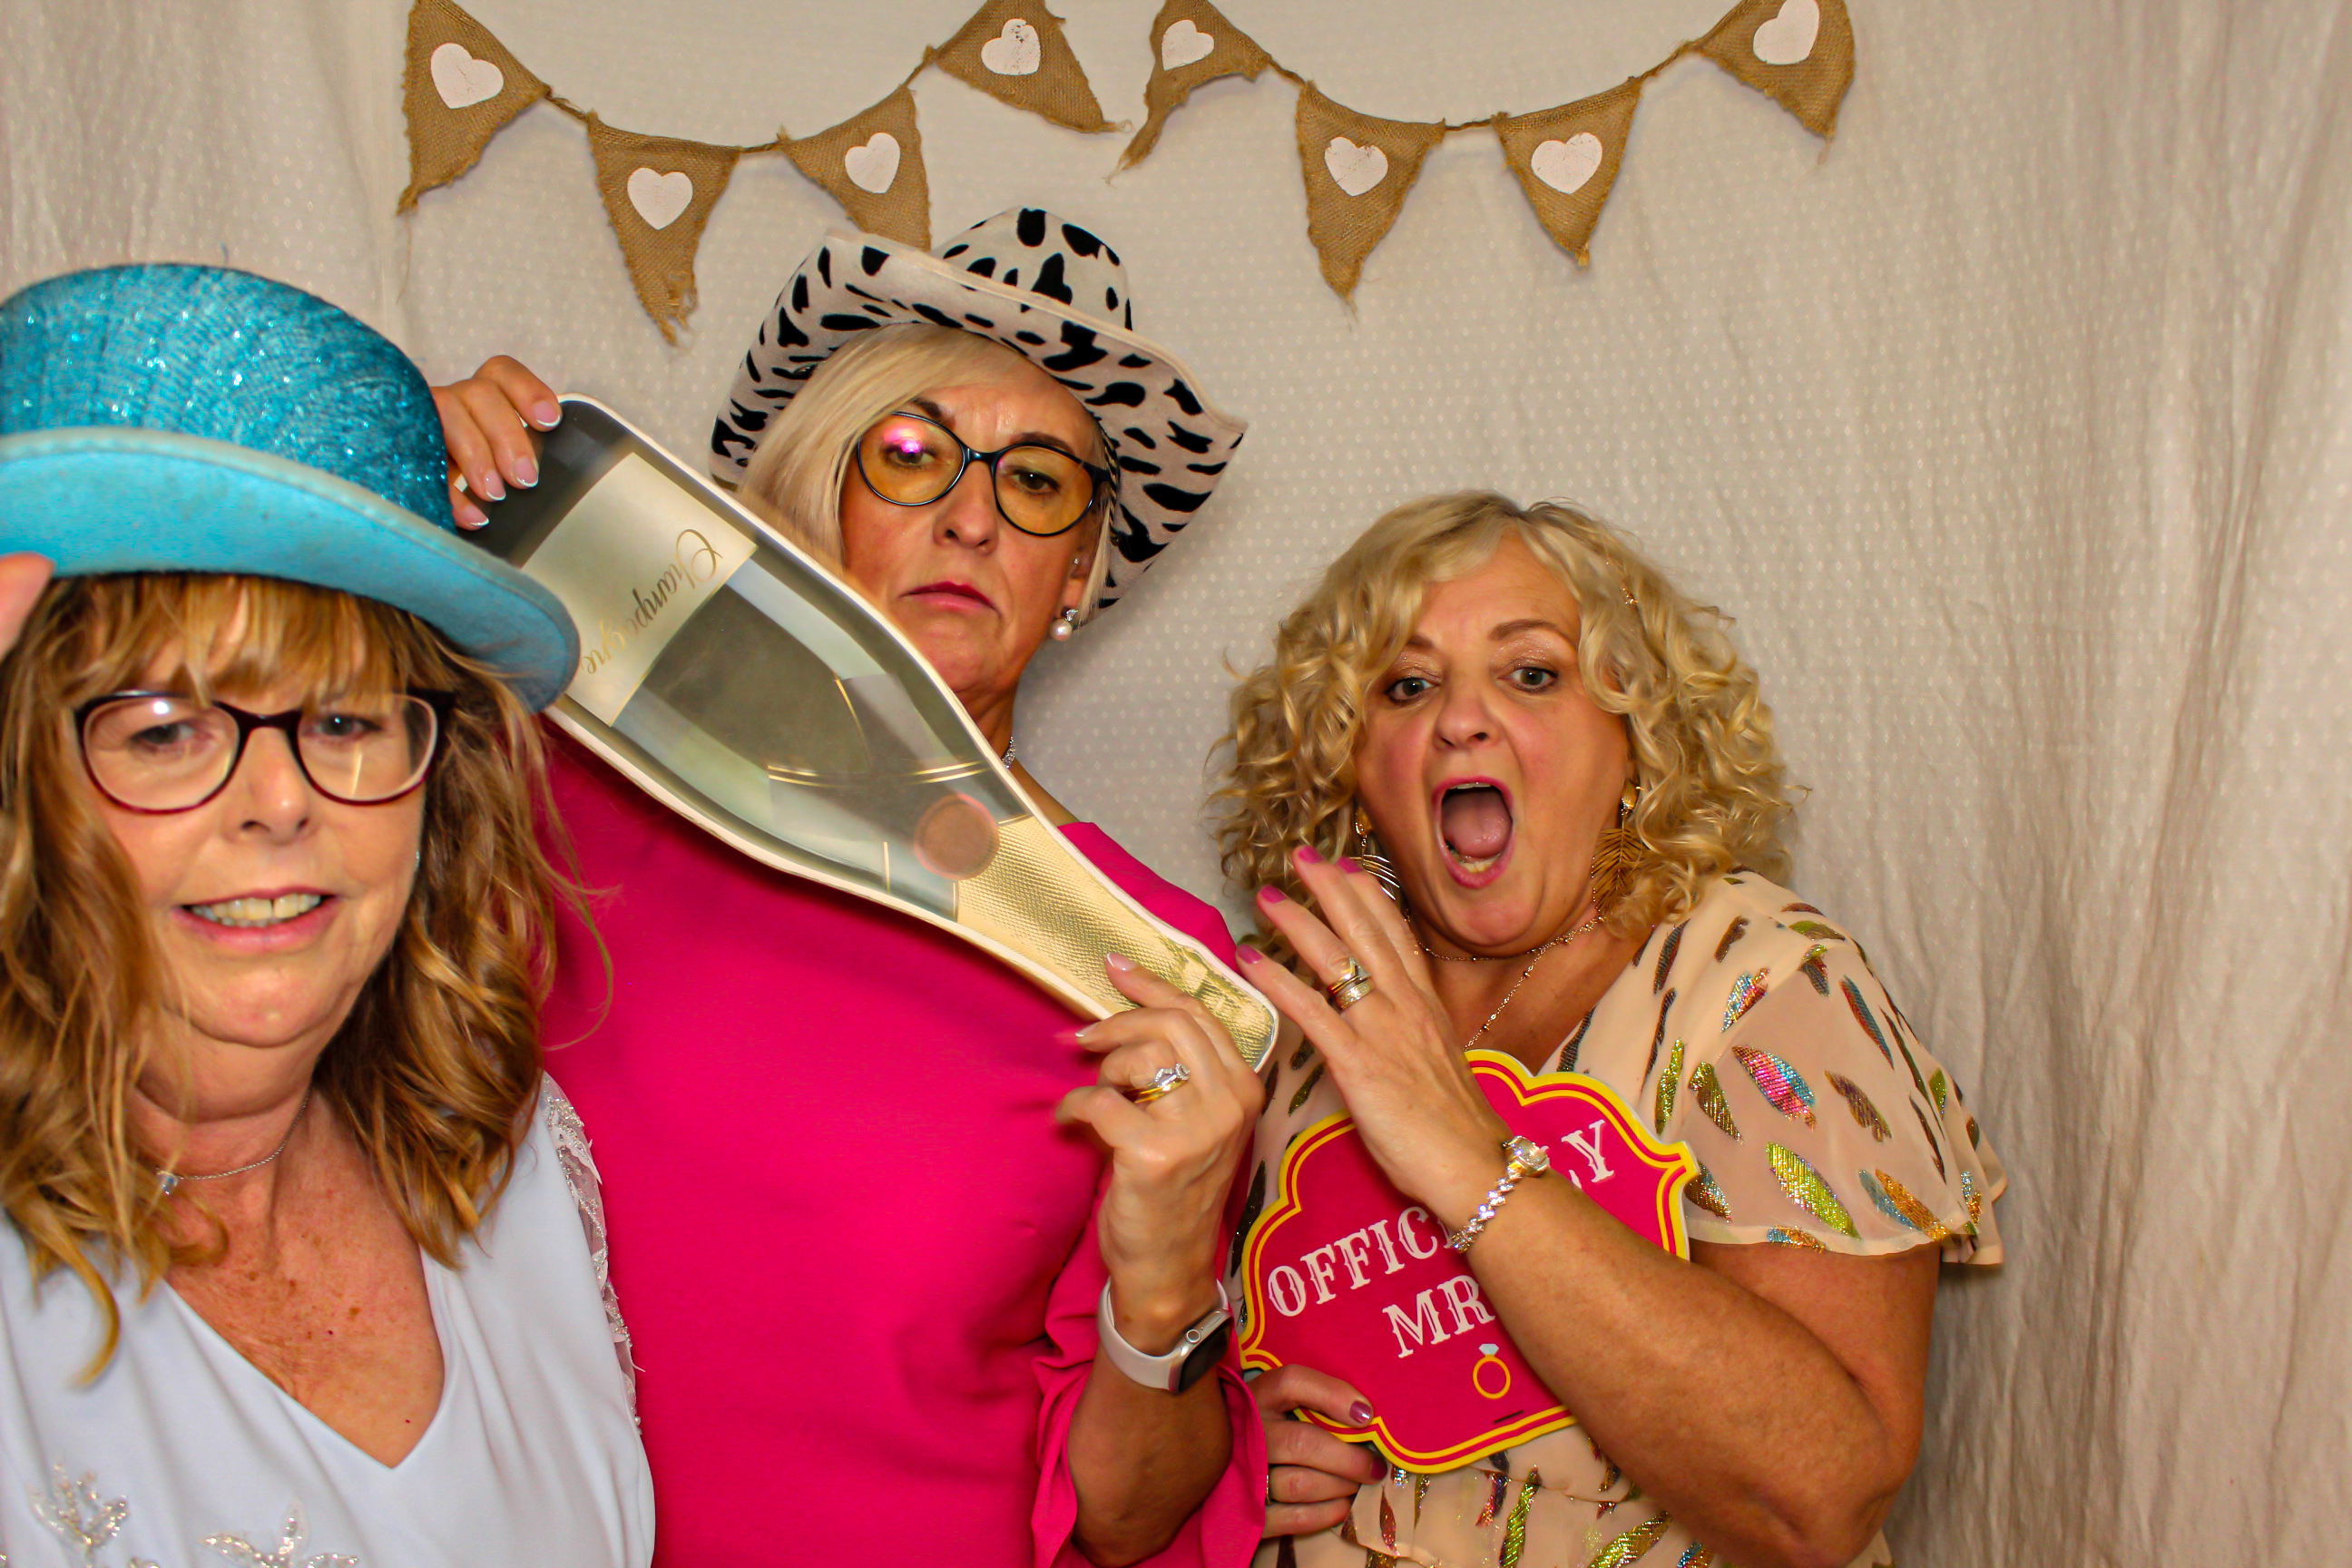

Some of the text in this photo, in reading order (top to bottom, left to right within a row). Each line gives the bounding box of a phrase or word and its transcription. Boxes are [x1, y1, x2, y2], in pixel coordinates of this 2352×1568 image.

[580, 528, 724, 675] Champagne
[1268, 1119, 1614, 1318] OFFICY
[1382, 1274, 1496, 1358] MR
